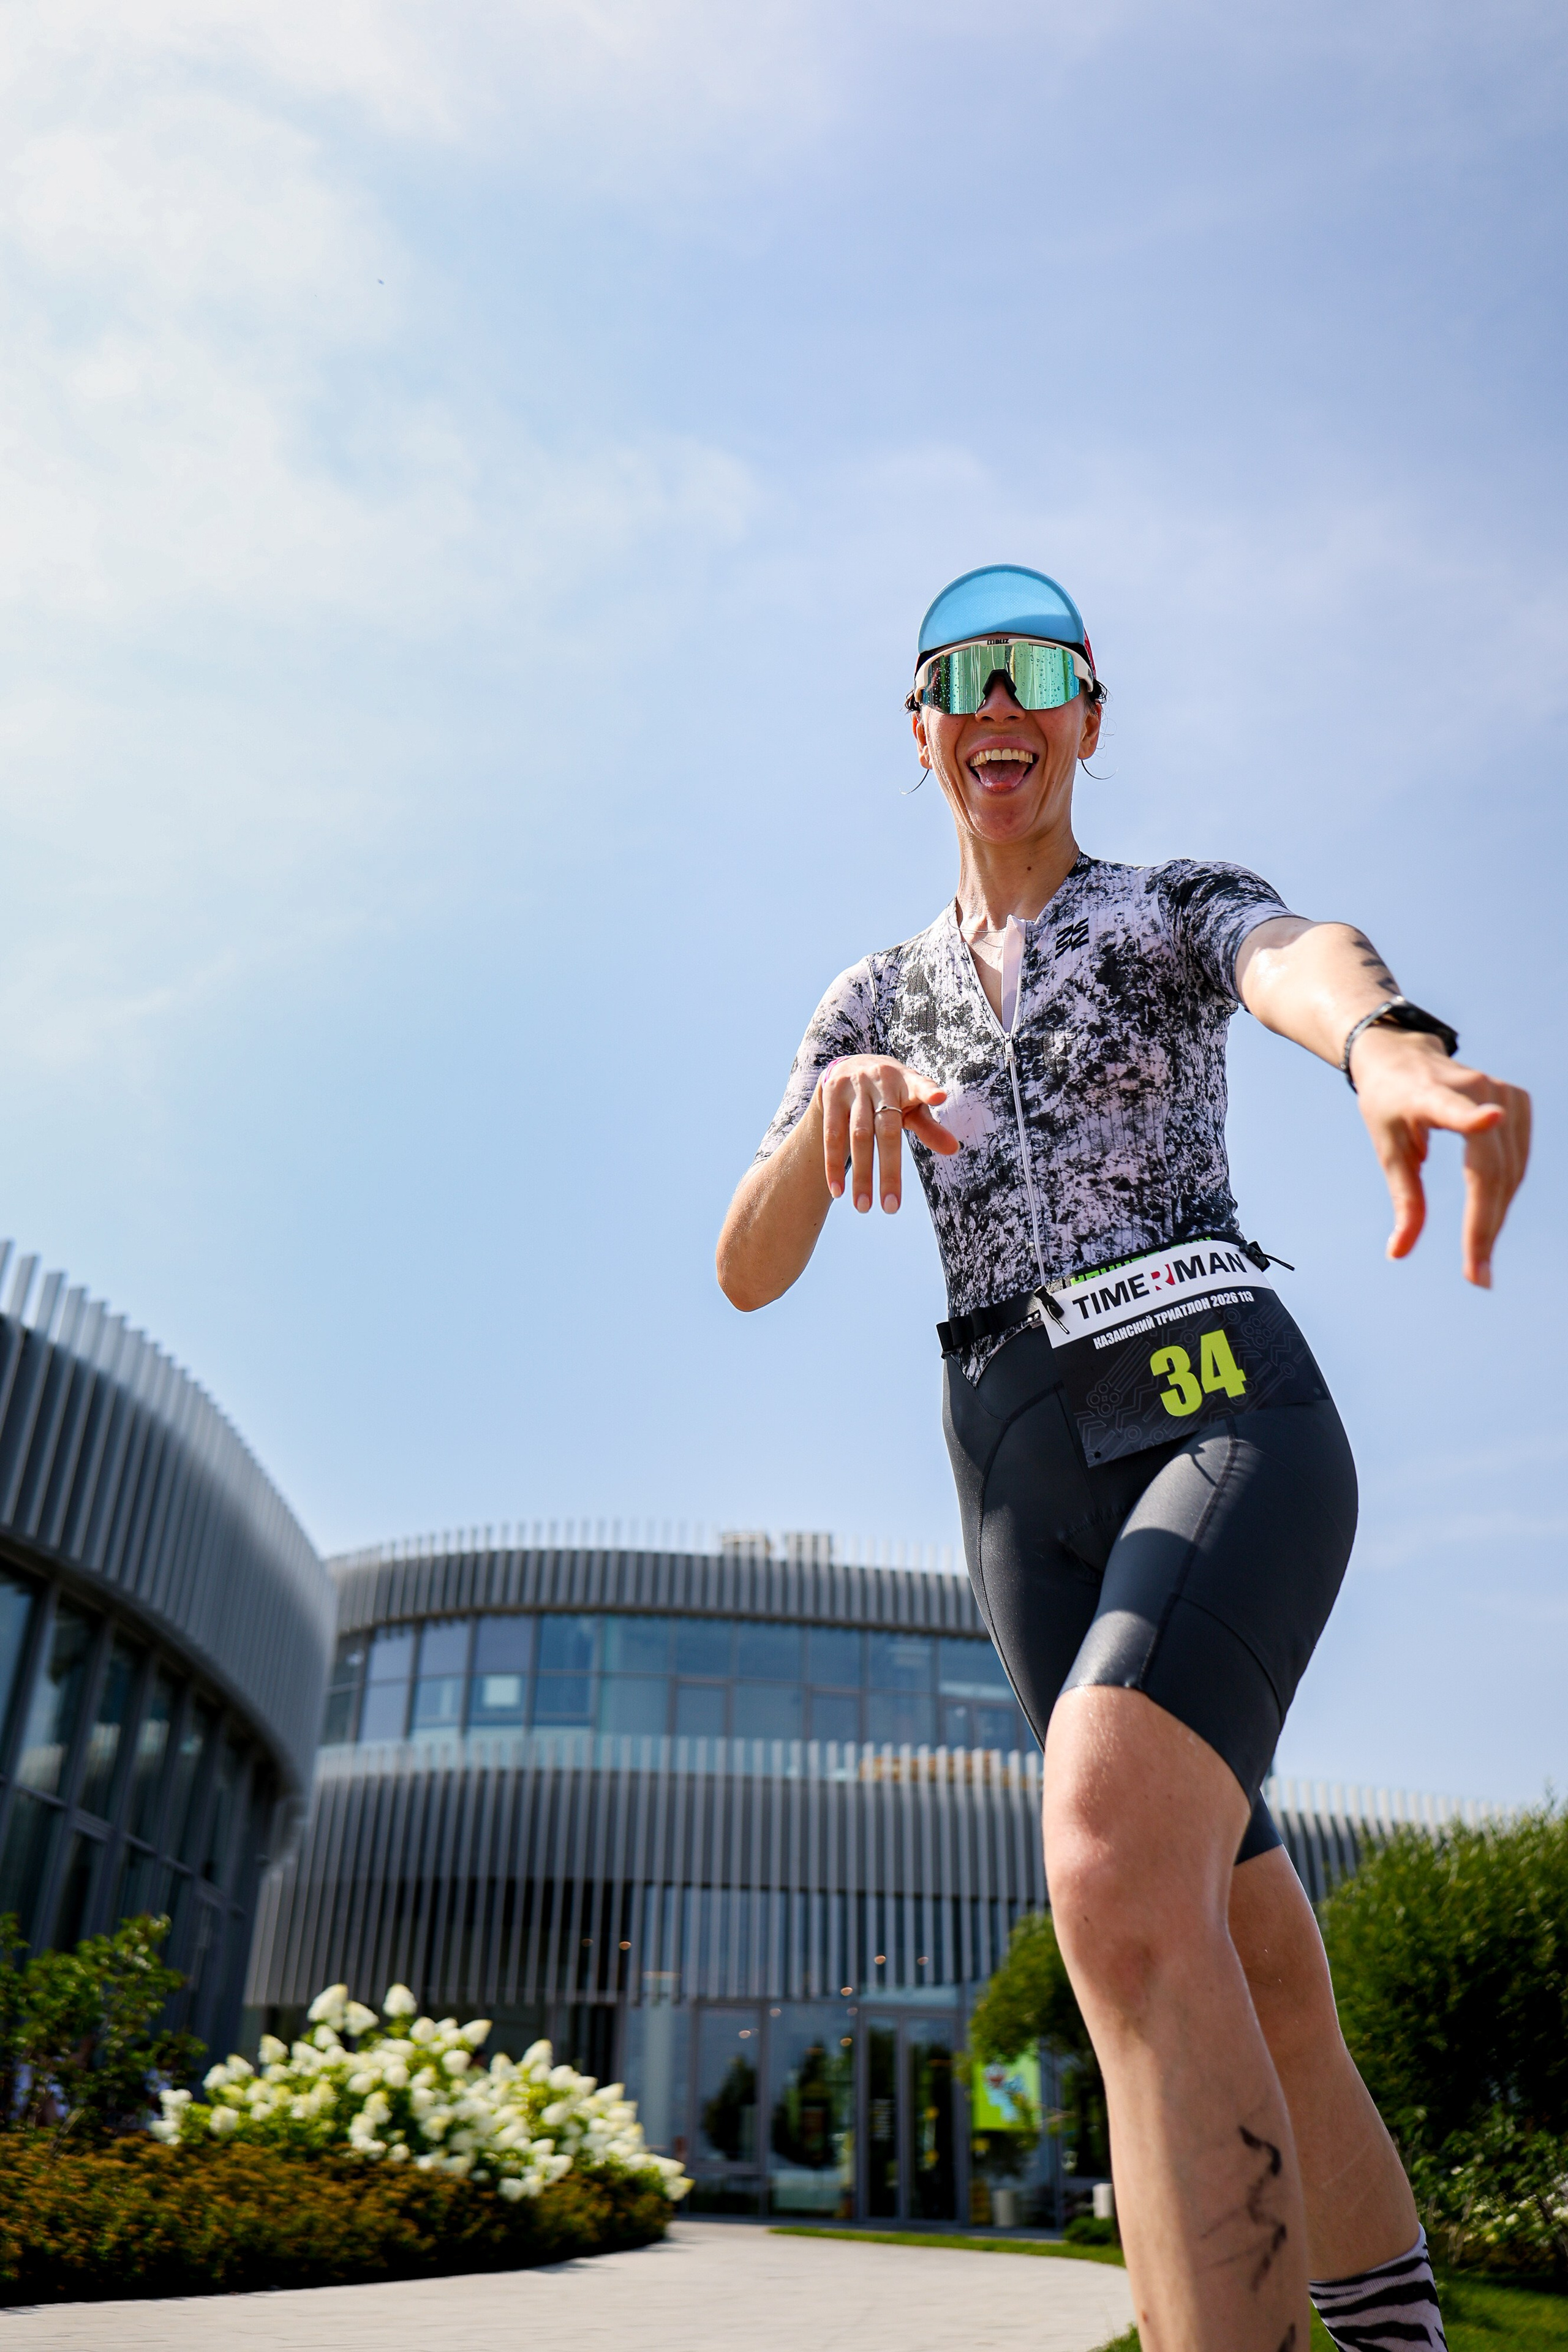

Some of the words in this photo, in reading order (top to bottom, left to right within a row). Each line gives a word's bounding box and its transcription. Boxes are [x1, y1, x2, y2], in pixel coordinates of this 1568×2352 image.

[1072, 1251, 1247, 1319] TIMERMAN
[1093, 1315, 1155, 1349] КАЗАНСКИЙ
[1154, 1297, 1210, 1325] ТРИАТЛОН
[1211, 1292, 1238, 1307] 2026
[1150, 1329, 1247, 1417] 34
